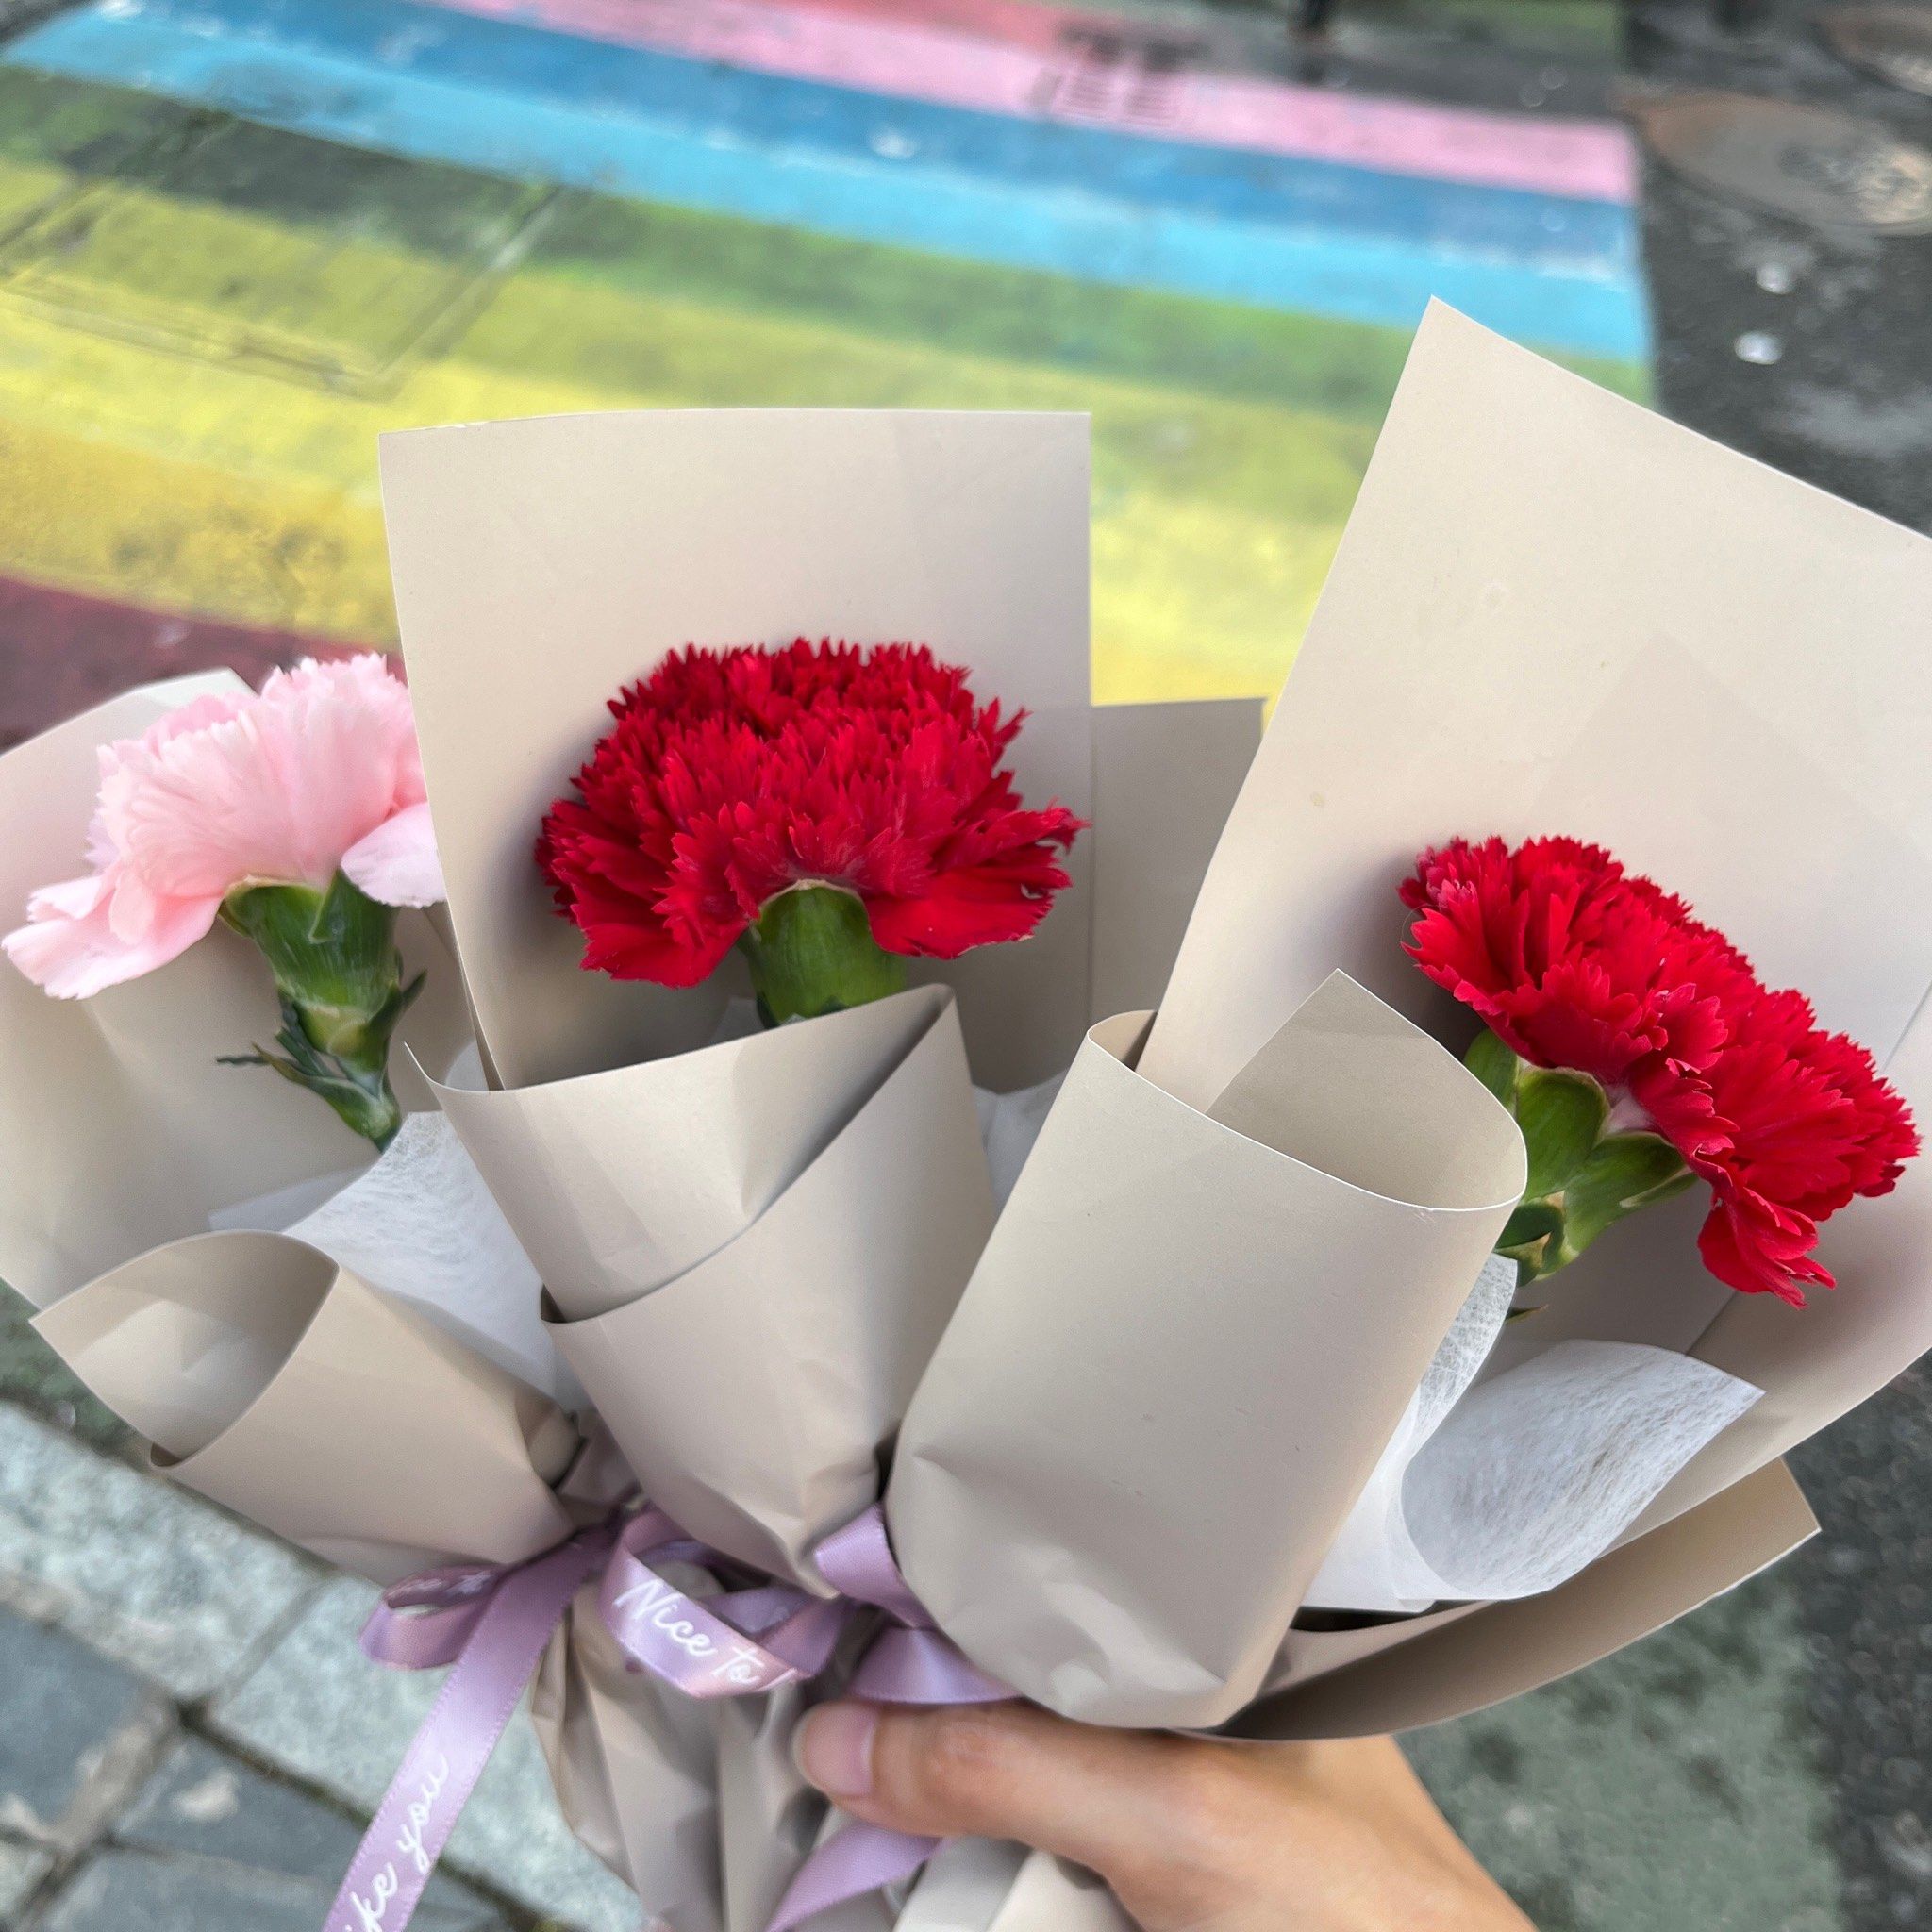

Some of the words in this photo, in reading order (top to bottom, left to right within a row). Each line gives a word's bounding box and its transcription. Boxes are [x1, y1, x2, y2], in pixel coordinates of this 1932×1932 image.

[613, 1577, 717, 1657] Nice
[345, 1861, 398, 1932] ke
[396, 1751, 449, 1874] you
